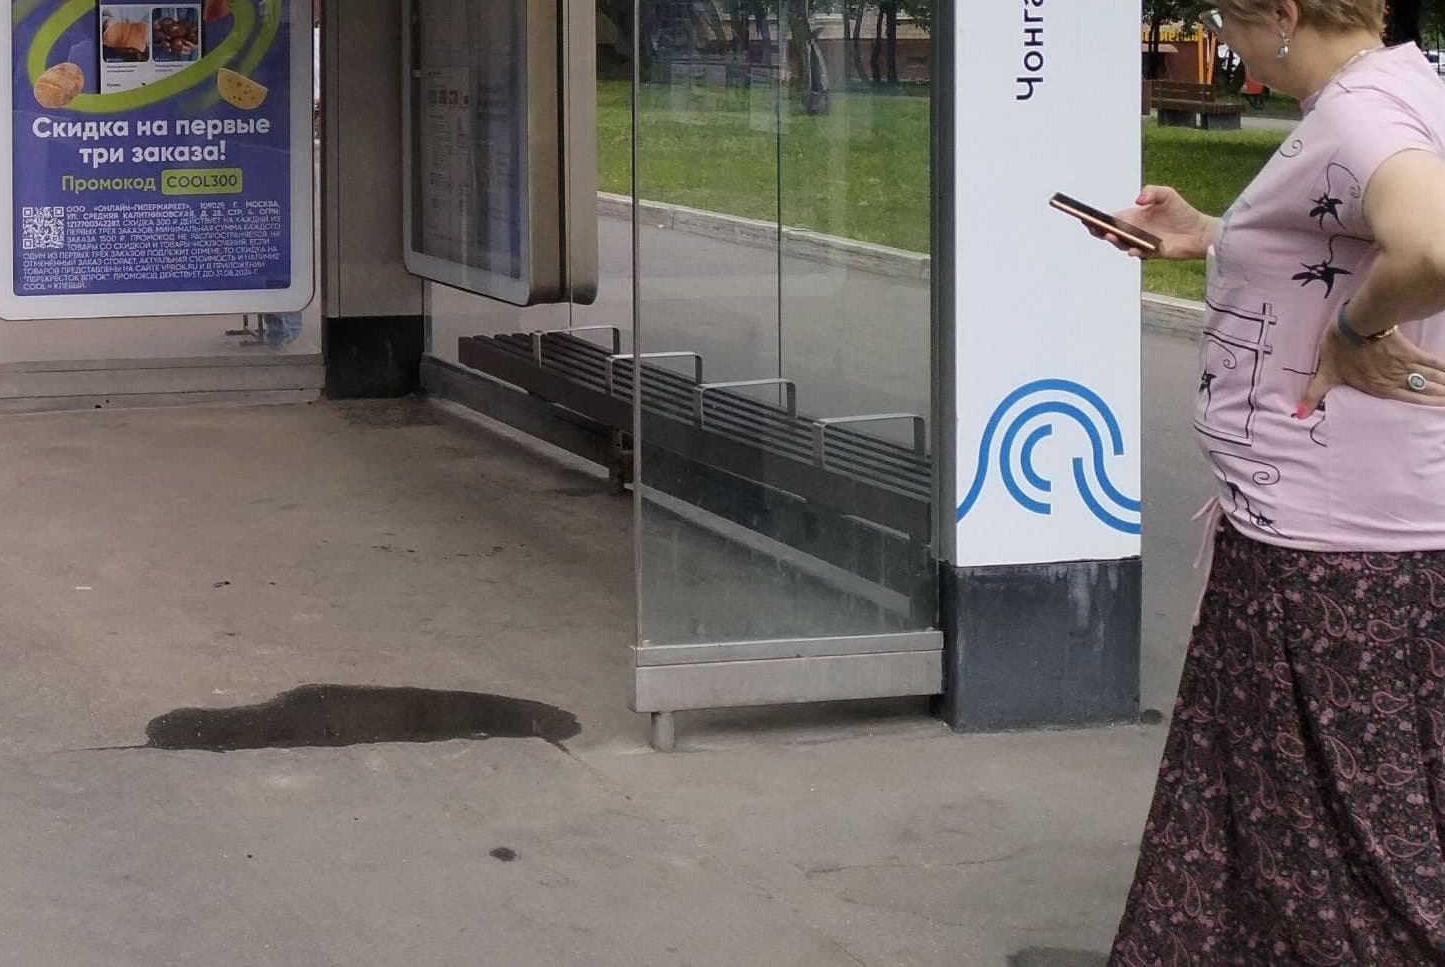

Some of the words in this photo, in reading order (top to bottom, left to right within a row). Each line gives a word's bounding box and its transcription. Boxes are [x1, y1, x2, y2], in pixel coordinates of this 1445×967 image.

[32, 116, 129, 140] Скидка
[137, 120, 167, 137] на
[176, 118, 271, 140] первые
[79, 146, 124, 168] три
[131, 140, 227, 164] заказа!
[62, 175, 155, 194] Промокод
[166, 175, 238, 188] COOL300
[66, 205, 86, 213] ООО
